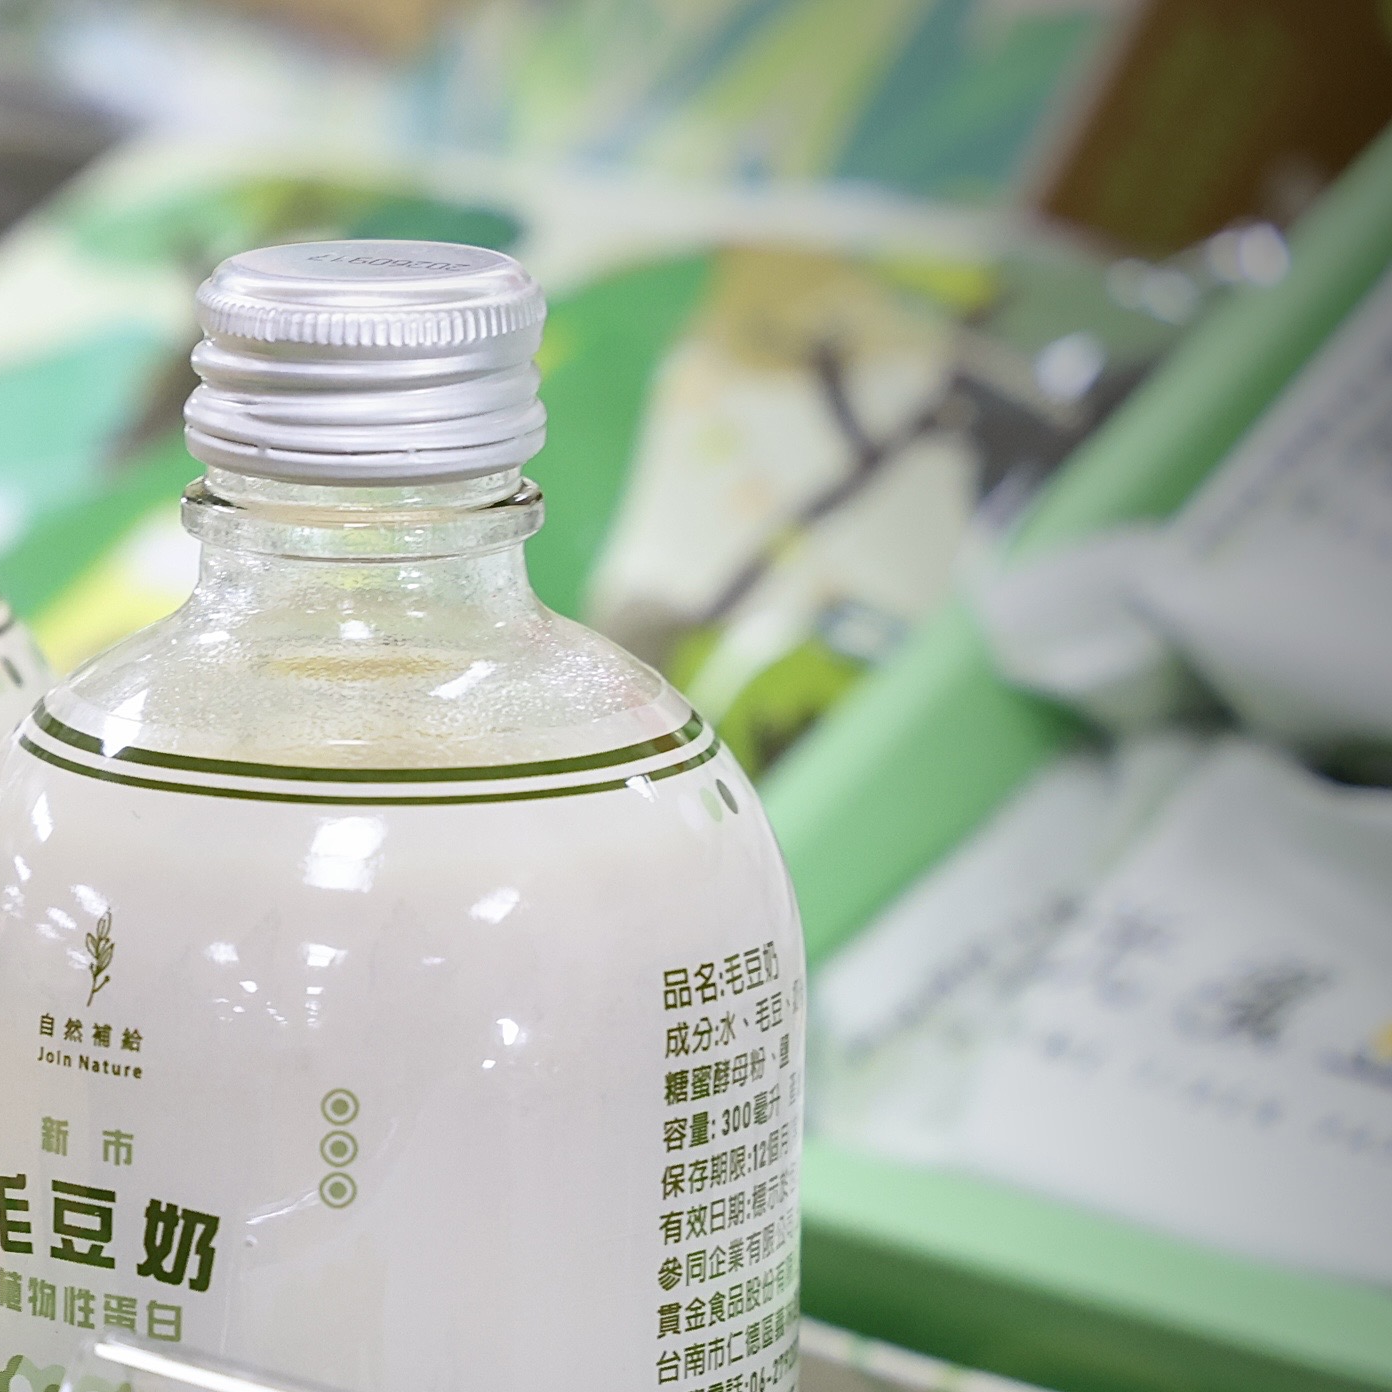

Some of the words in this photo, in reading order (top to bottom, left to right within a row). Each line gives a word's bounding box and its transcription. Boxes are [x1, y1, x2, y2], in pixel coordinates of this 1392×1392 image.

[39, 1013, 143, 1052] 自然補給
[37, 1046, 73, 1067] Join
[78, 1054, 144, 1079] Nature
[41, 1115, 135, 1167] 新市
